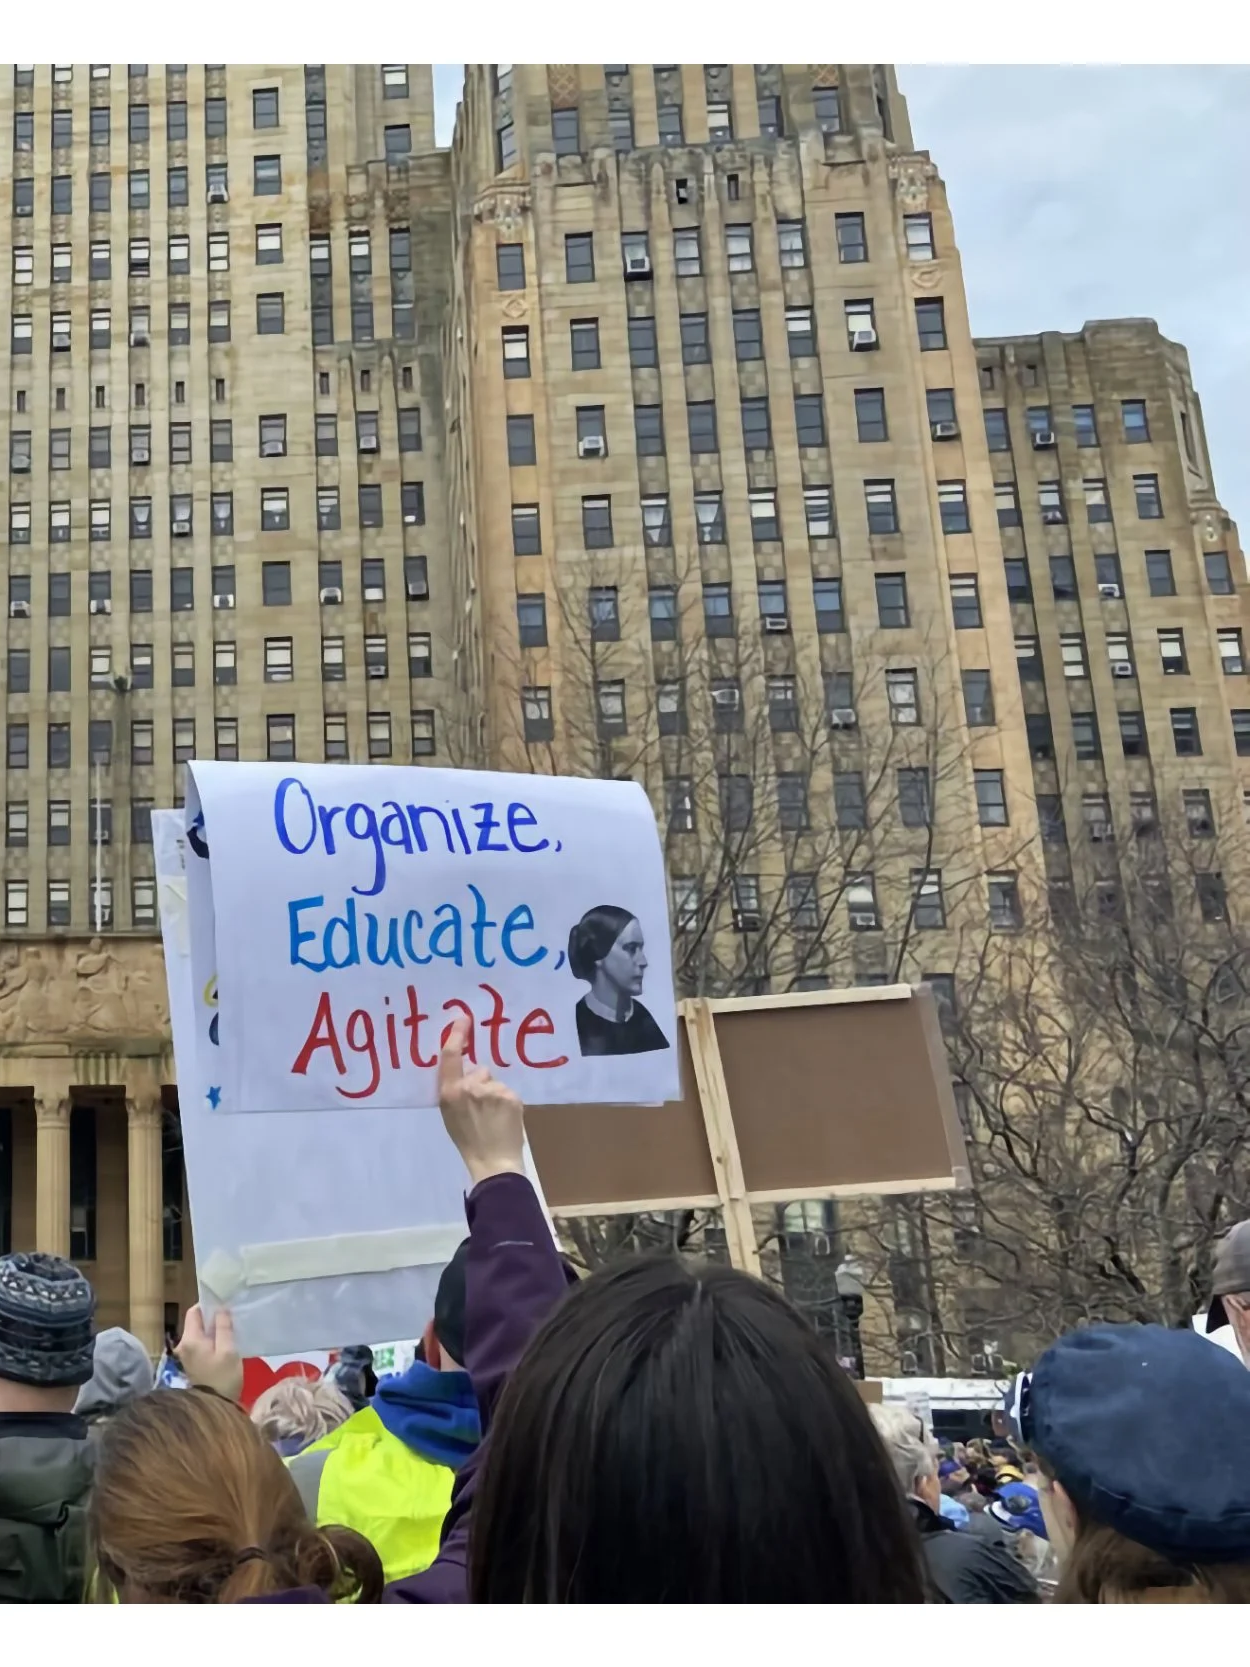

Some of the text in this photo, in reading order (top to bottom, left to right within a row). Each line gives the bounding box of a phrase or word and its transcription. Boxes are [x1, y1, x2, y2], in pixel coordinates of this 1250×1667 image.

[273, 777, 562, 896] Organize,
[288, 883, 565, 972] Educate,
[290, 983, 569, 1098] Agitate
